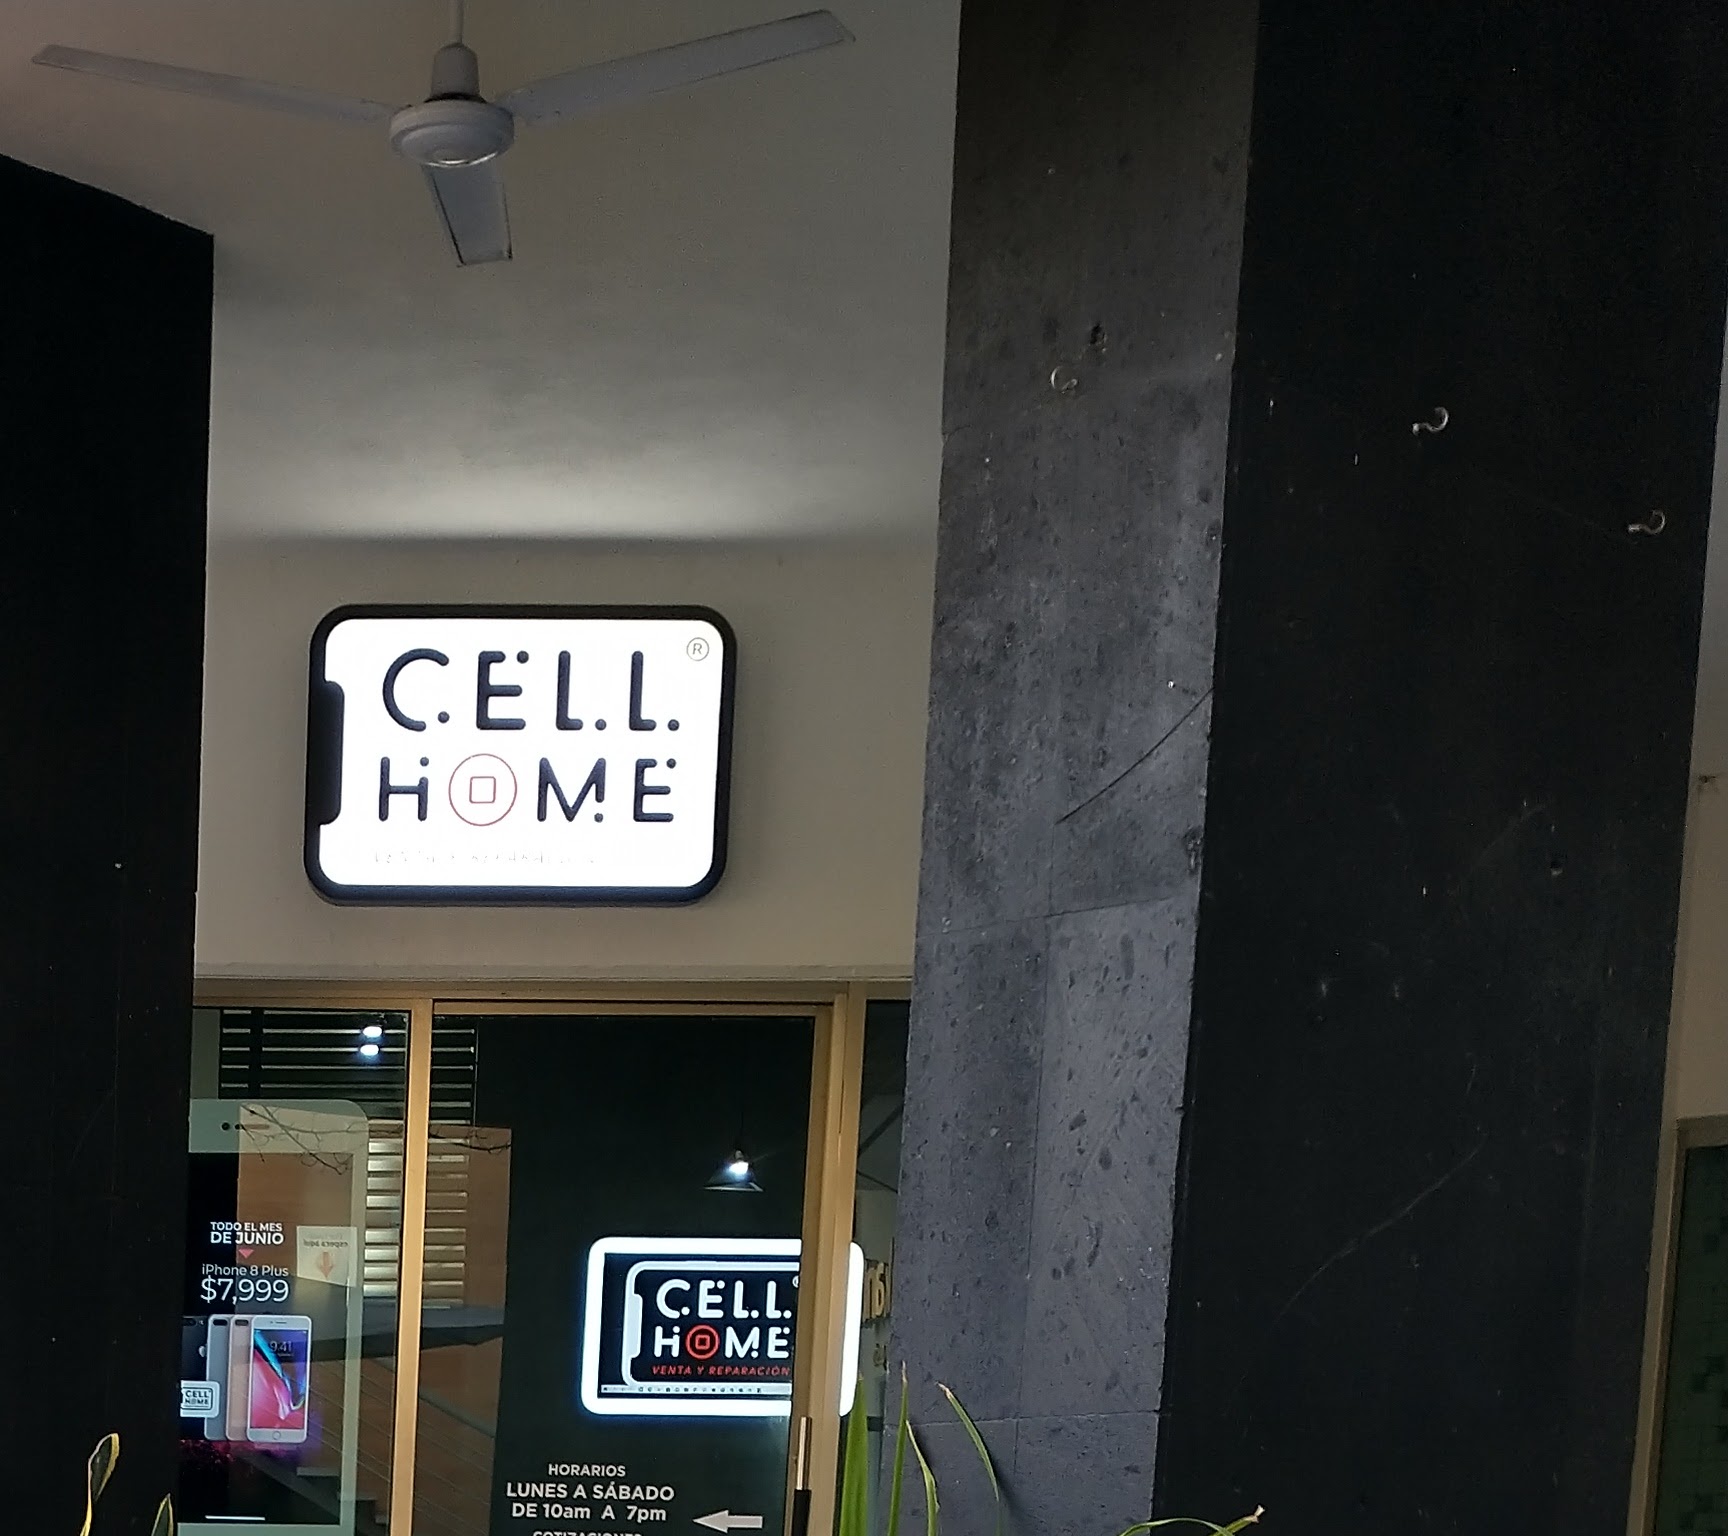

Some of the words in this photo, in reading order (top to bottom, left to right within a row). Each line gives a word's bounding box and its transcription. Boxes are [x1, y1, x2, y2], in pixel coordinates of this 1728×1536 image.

[382, 647, 680, 732] CELL
[378, 753, 678, 827] HOME
[210, 1221, 242, 1231] TODO
[245, 1222, 256, 1231] EL
[259, 1222, 282, 1232] MES
[210, 1231, 232, 1244] DE
[235, 1232, 284, 1245] JUNIO
[202, 1263, 246, 1276] iPhone
[250, 1266, 258, 1276] 8
[262, 1265, 289, 1277] Plus
[200, 1274, 289, 1305] $7,999
[656, 1278, 792, 1319] CELL
[653, 1325, 791, 1360] HOME
[652, 1366, 691, 1376] VENTA
[697, 1366, 705, 1376] Y
[548, 1463, 626, 1477] HORARIOS
[506, 1482, 568, 1498] LUNES
[573, 1484, 587, 1499] A
[593, 1480, 674, 1501] SÁBADO
[512, 1503, 537, 1518] DE
[543, 1503, 590, 1520] 10am
[601, 1505, 615, 1520] A
[626, 1505, 666, 1523] 7pm
